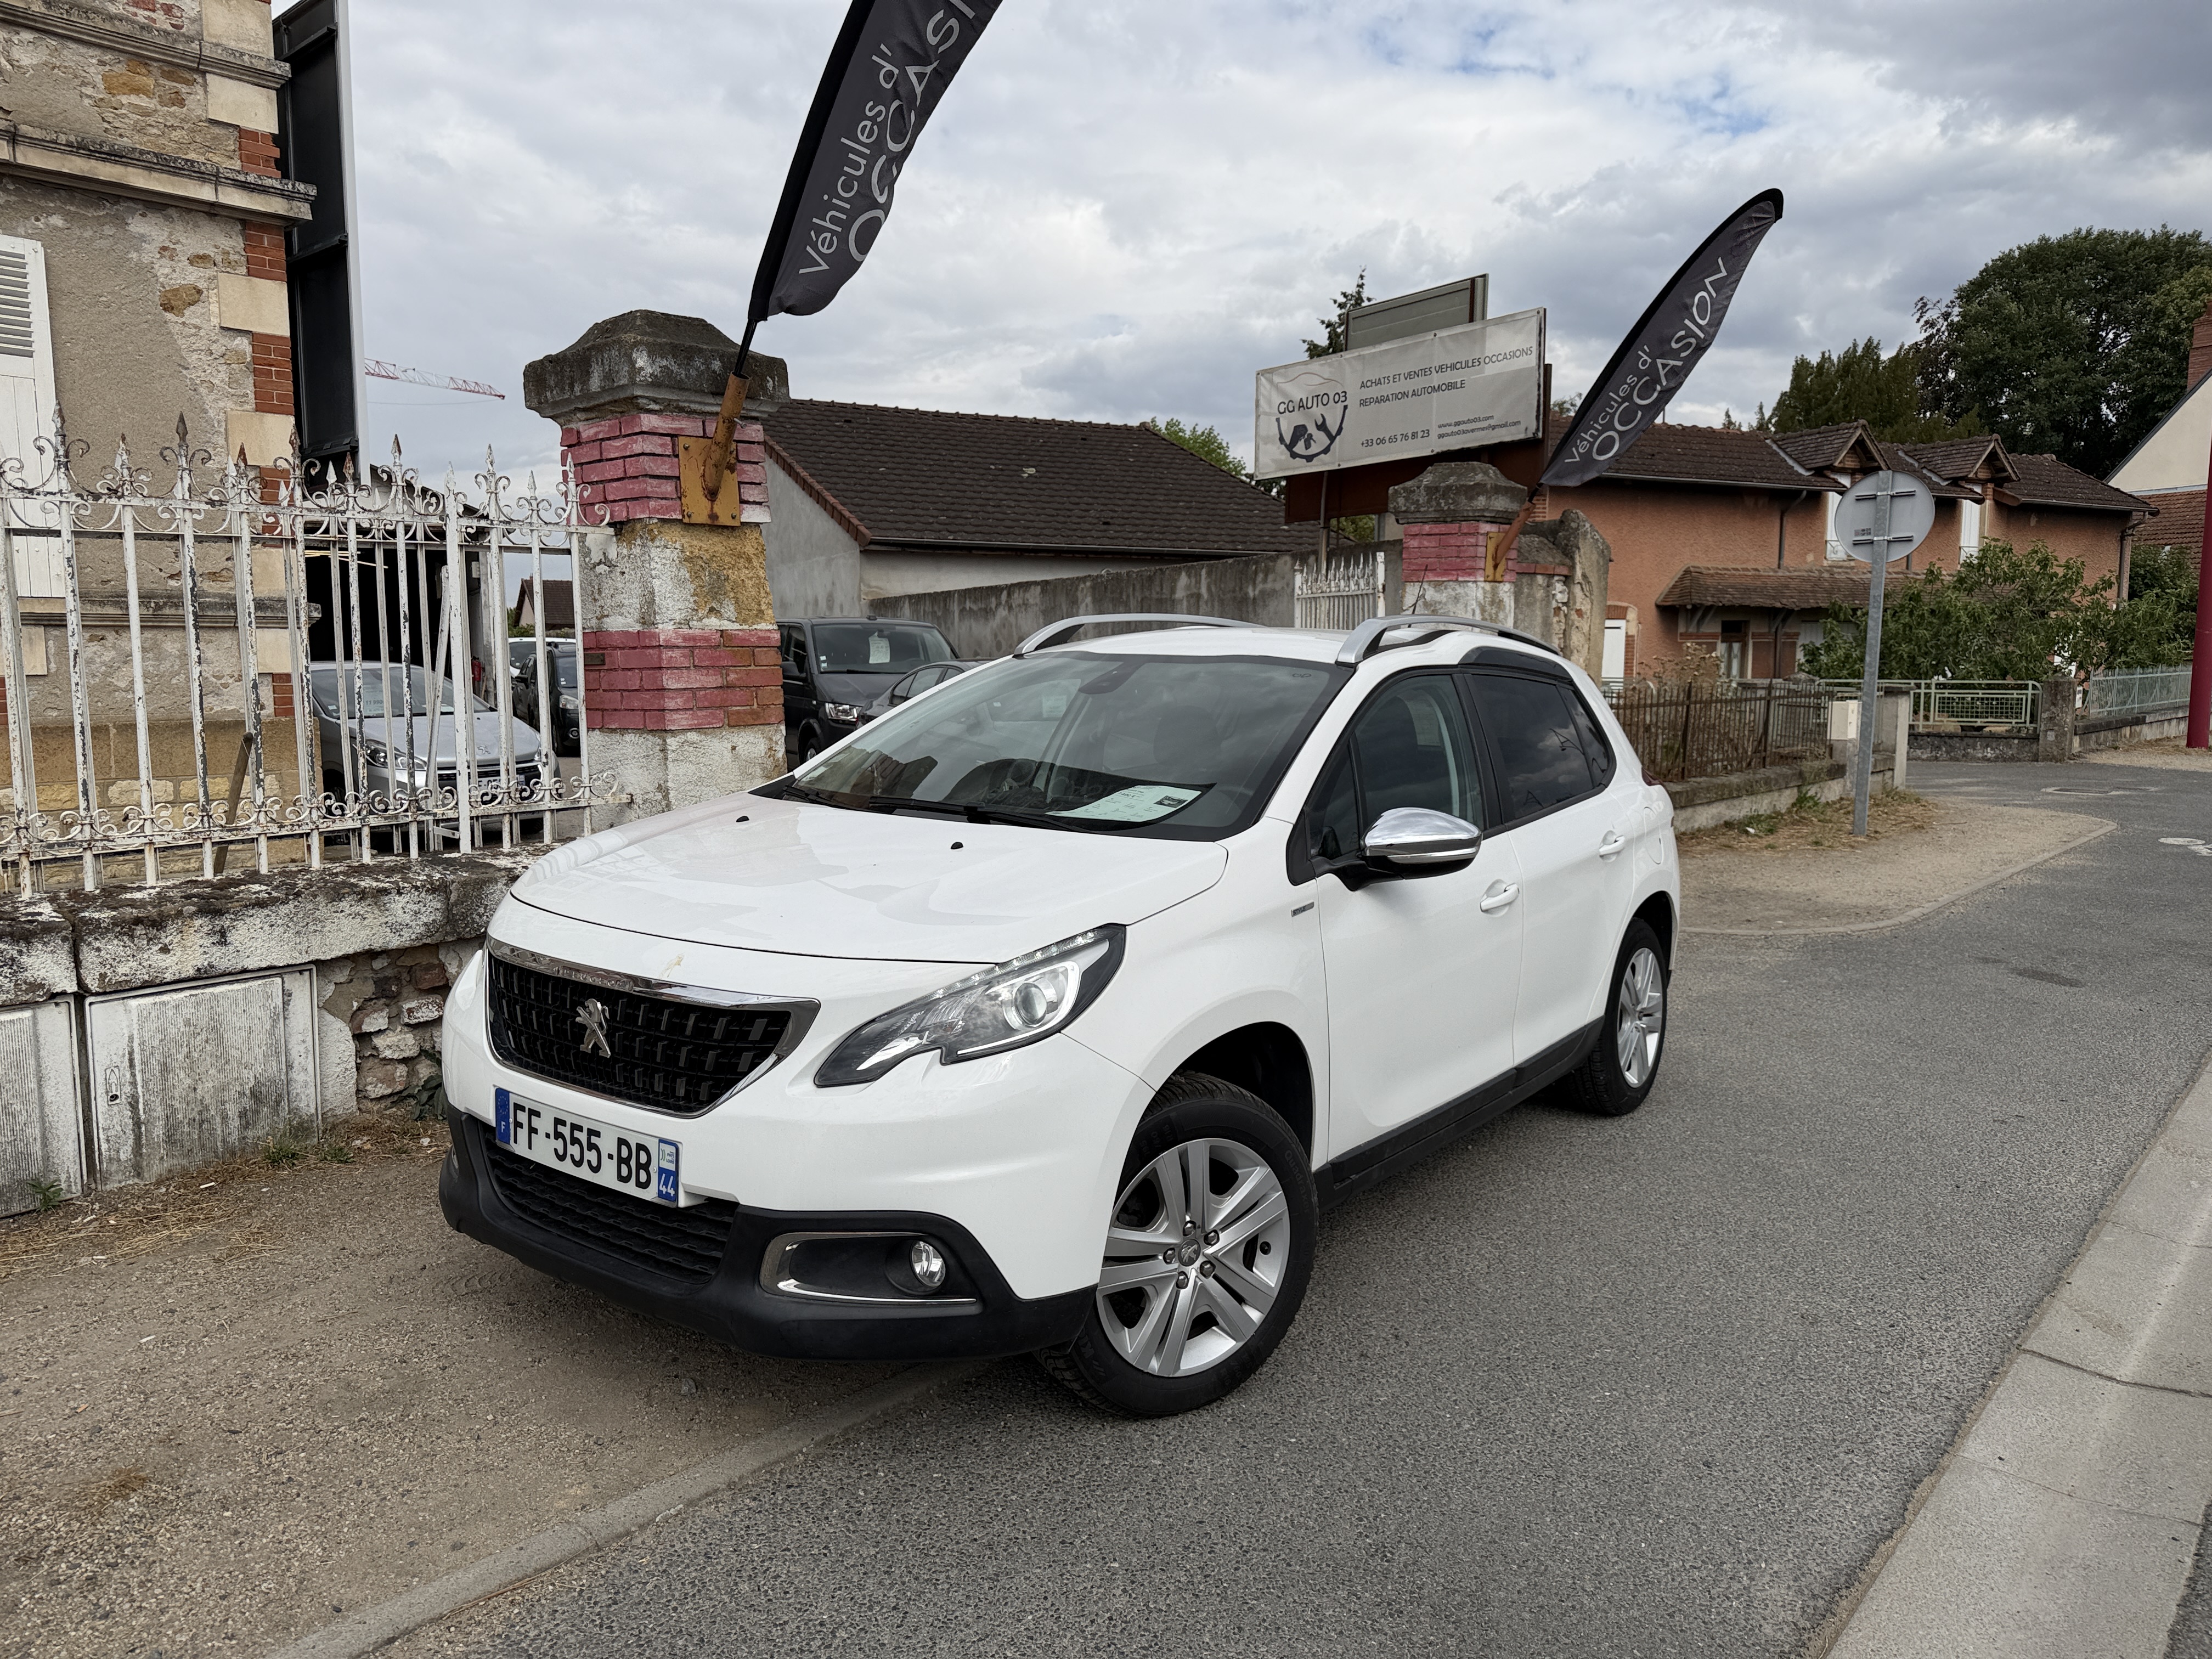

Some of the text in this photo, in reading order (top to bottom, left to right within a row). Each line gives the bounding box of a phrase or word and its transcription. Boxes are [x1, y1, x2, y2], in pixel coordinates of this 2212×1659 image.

[799, 100, 886, 274] Véhicules
[1359, 346, 1533, 390] ACHATS ET VENTES VEHICULES OCCASIONS
[1593, 257, 1728, 461] OCCASION
[1277, 391, 1347, 415] GG AUTO 03
[1359, 379, 1466, 408] REPARATION AUTOMOBILE
[1437, 415, 1494, 429] www.ggauto03.com
[1564, 374, 1638, 464] Véhicules
[1361, 429, 1430, 448] +33 06 65 76 81 23
[500, 1121, 506, 1133] F
[512, 1102, 652, 1190] FF-555-BB
[659, 1173, 675, 1197] 44
